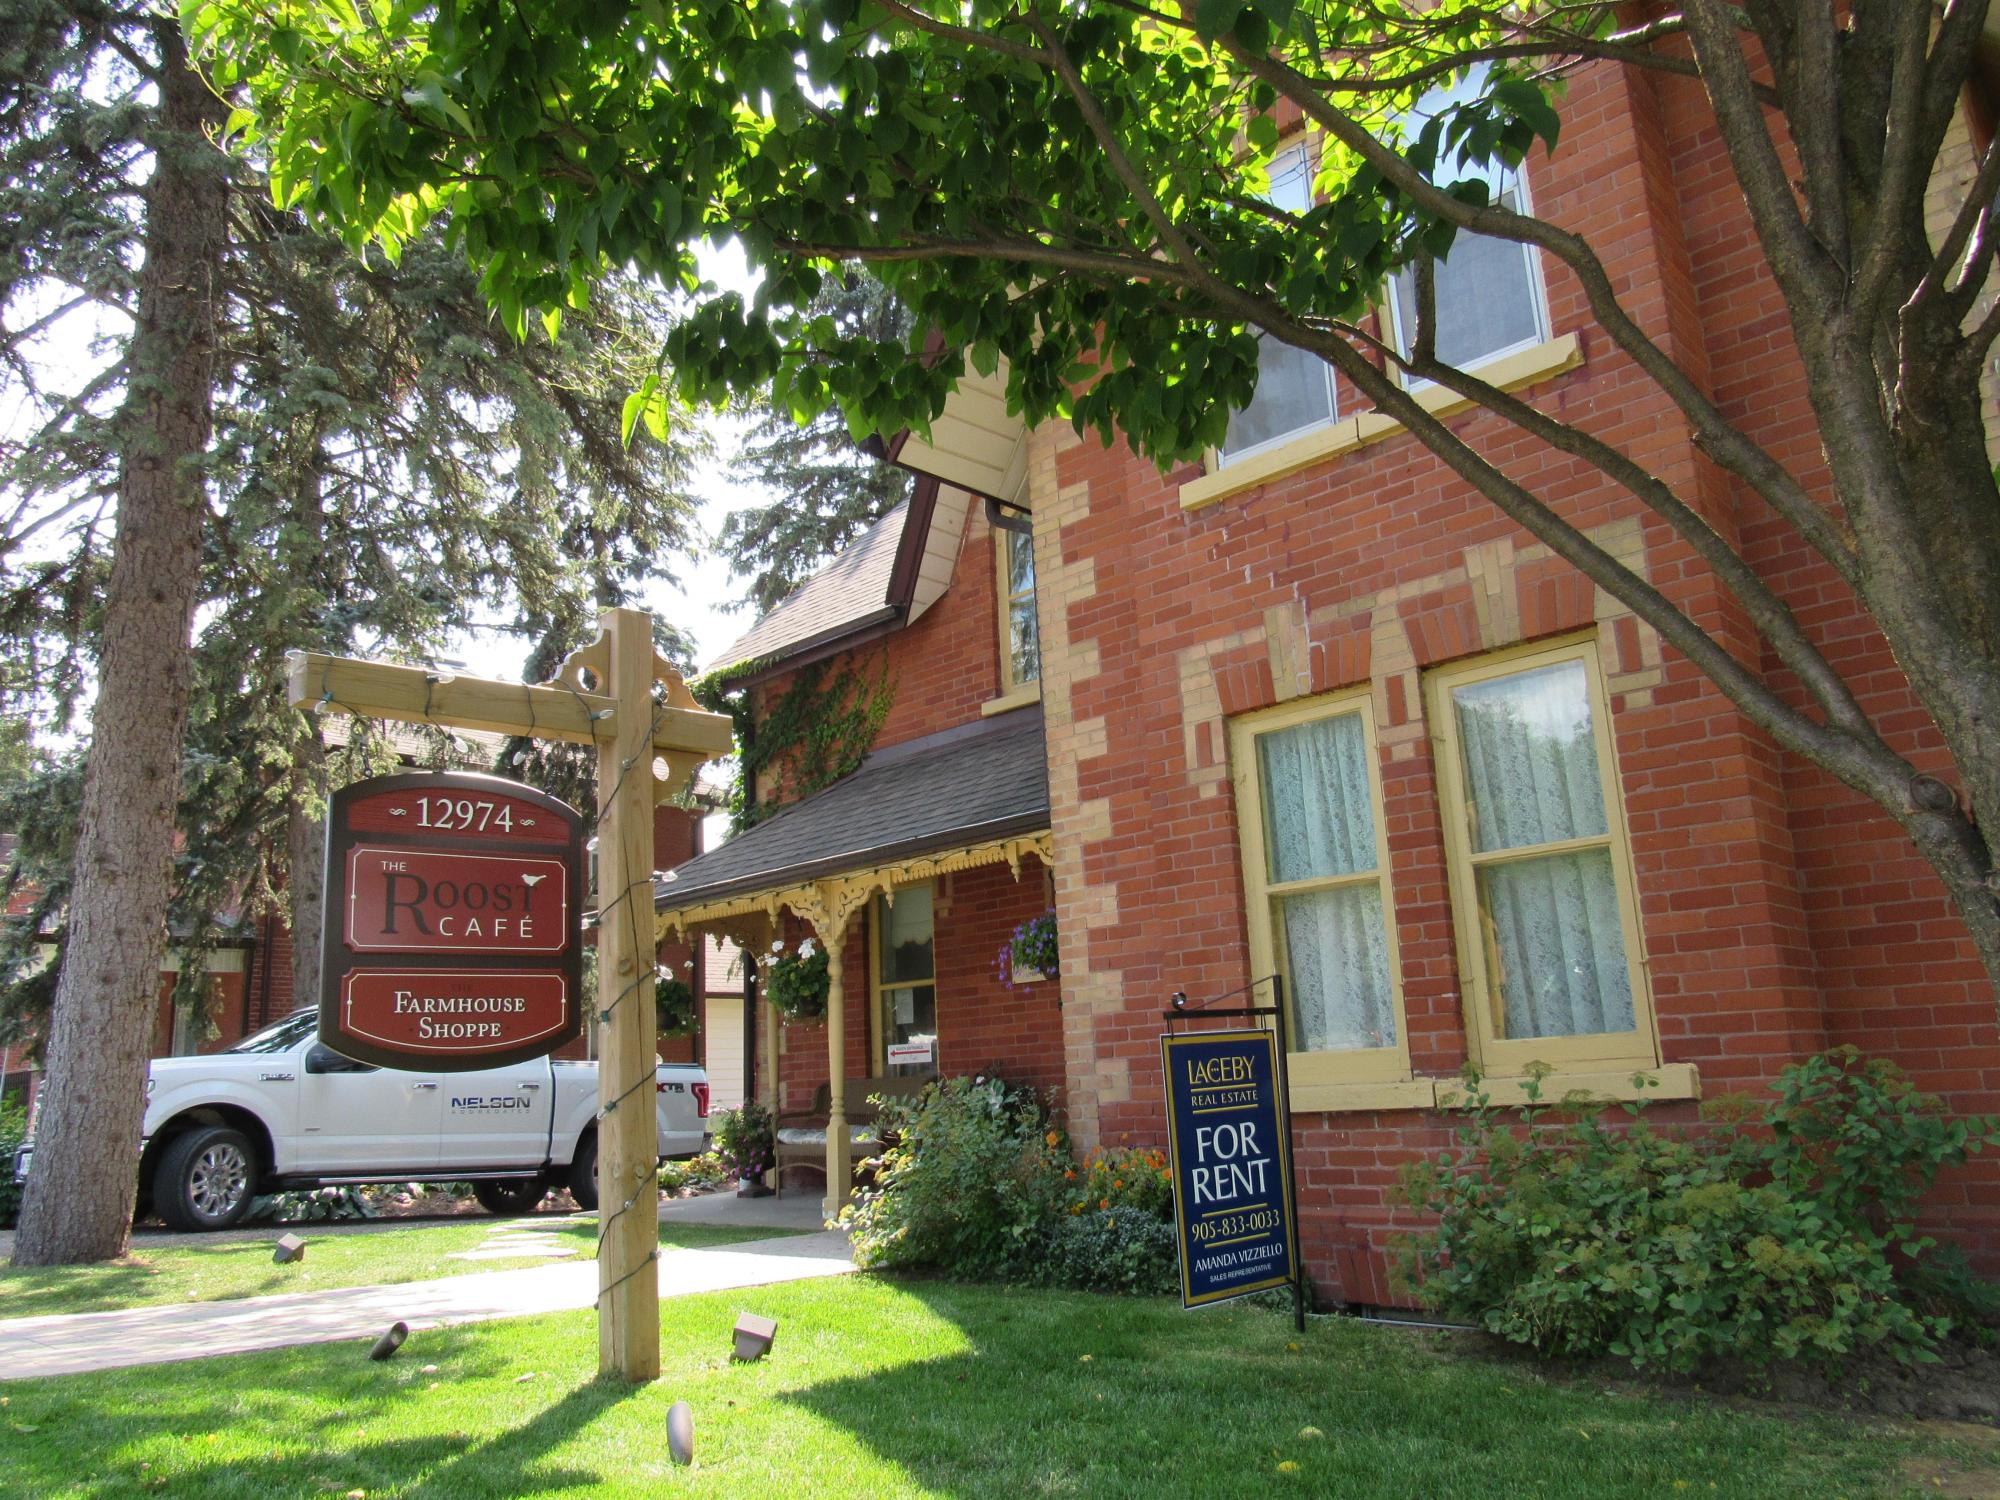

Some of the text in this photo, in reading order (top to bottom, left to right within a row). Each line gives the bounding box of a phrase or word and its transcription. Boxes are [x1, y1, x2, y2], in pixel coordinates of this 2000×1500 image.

[416, 797, 513, 833] 12974
[381, 860, 408, 872] THE
[379, 872, 538, 935] ROOST
[439, 915, 533, 938] CAFÉ
[394, 991, 526, 1013] FARMHOUSE
[419, 1016, 502, 1039] SHOPPE
[1187, 1055, 1255, 1085] LACEBY
[451, 1096, 531, 1109] NELSON
[1191, 1089, 1259, 1107] REAL ESTATE
[1196, 1121, 1262, 1162] FOR
[1191, 1158, 1271, 1204] RENT
[1191, 1209, 1280, 1242] 905-833-0033
[1195, 1242, 1283, 1273] AMANDA VIZZIELLO
[1209, 1262, 1272, 1283] SALES REPRESENTATIVE
